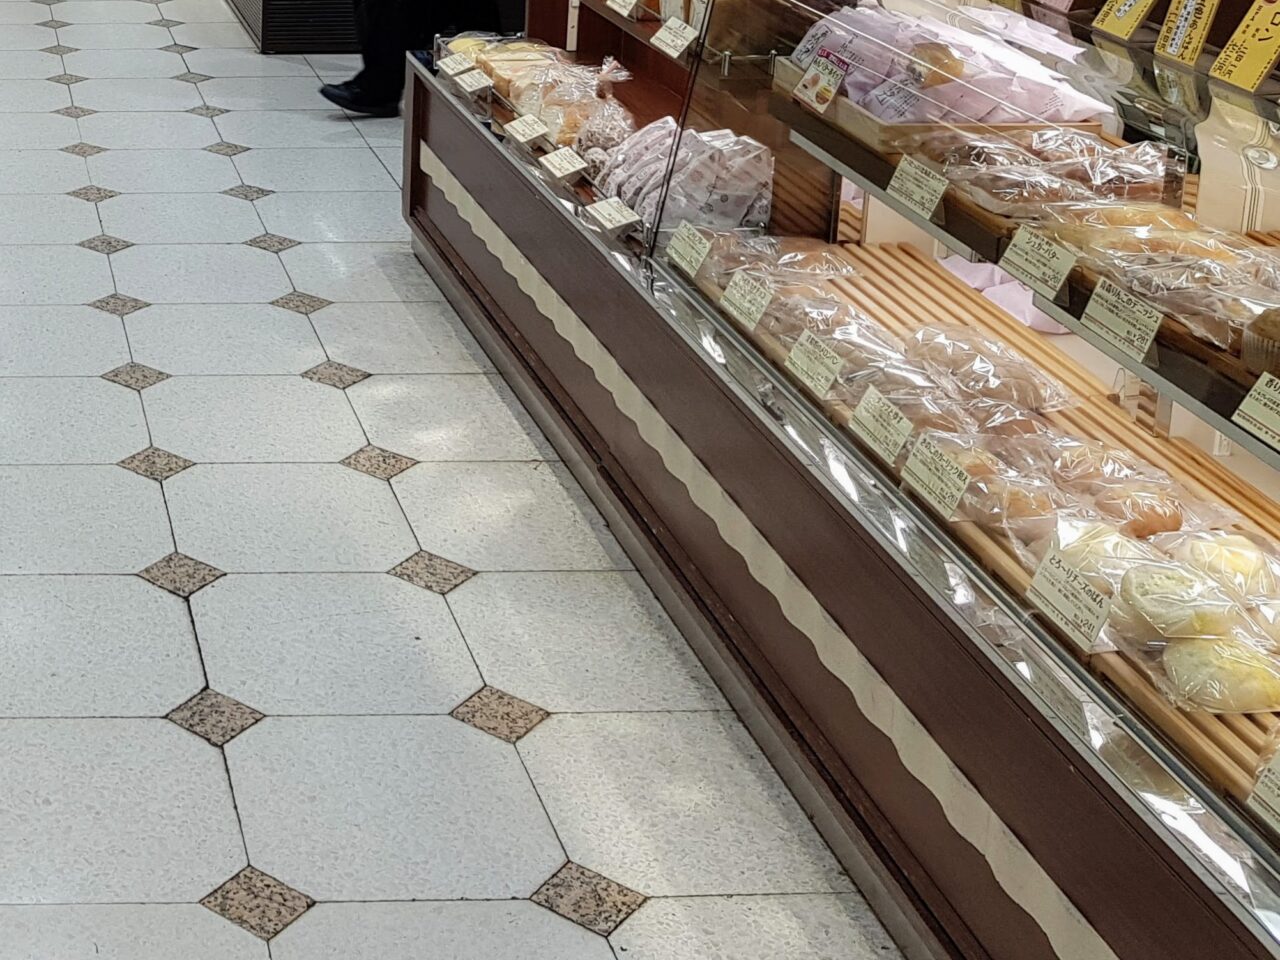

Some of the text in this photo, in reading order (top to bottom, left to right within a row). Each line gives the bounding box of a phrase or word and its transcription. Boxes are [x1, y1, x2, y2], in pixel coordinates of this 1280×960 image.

[1026, 235, 1061, 261] シュガーバター
[1100, 280, 1160, 324] 青森りんごのデニッシュ
